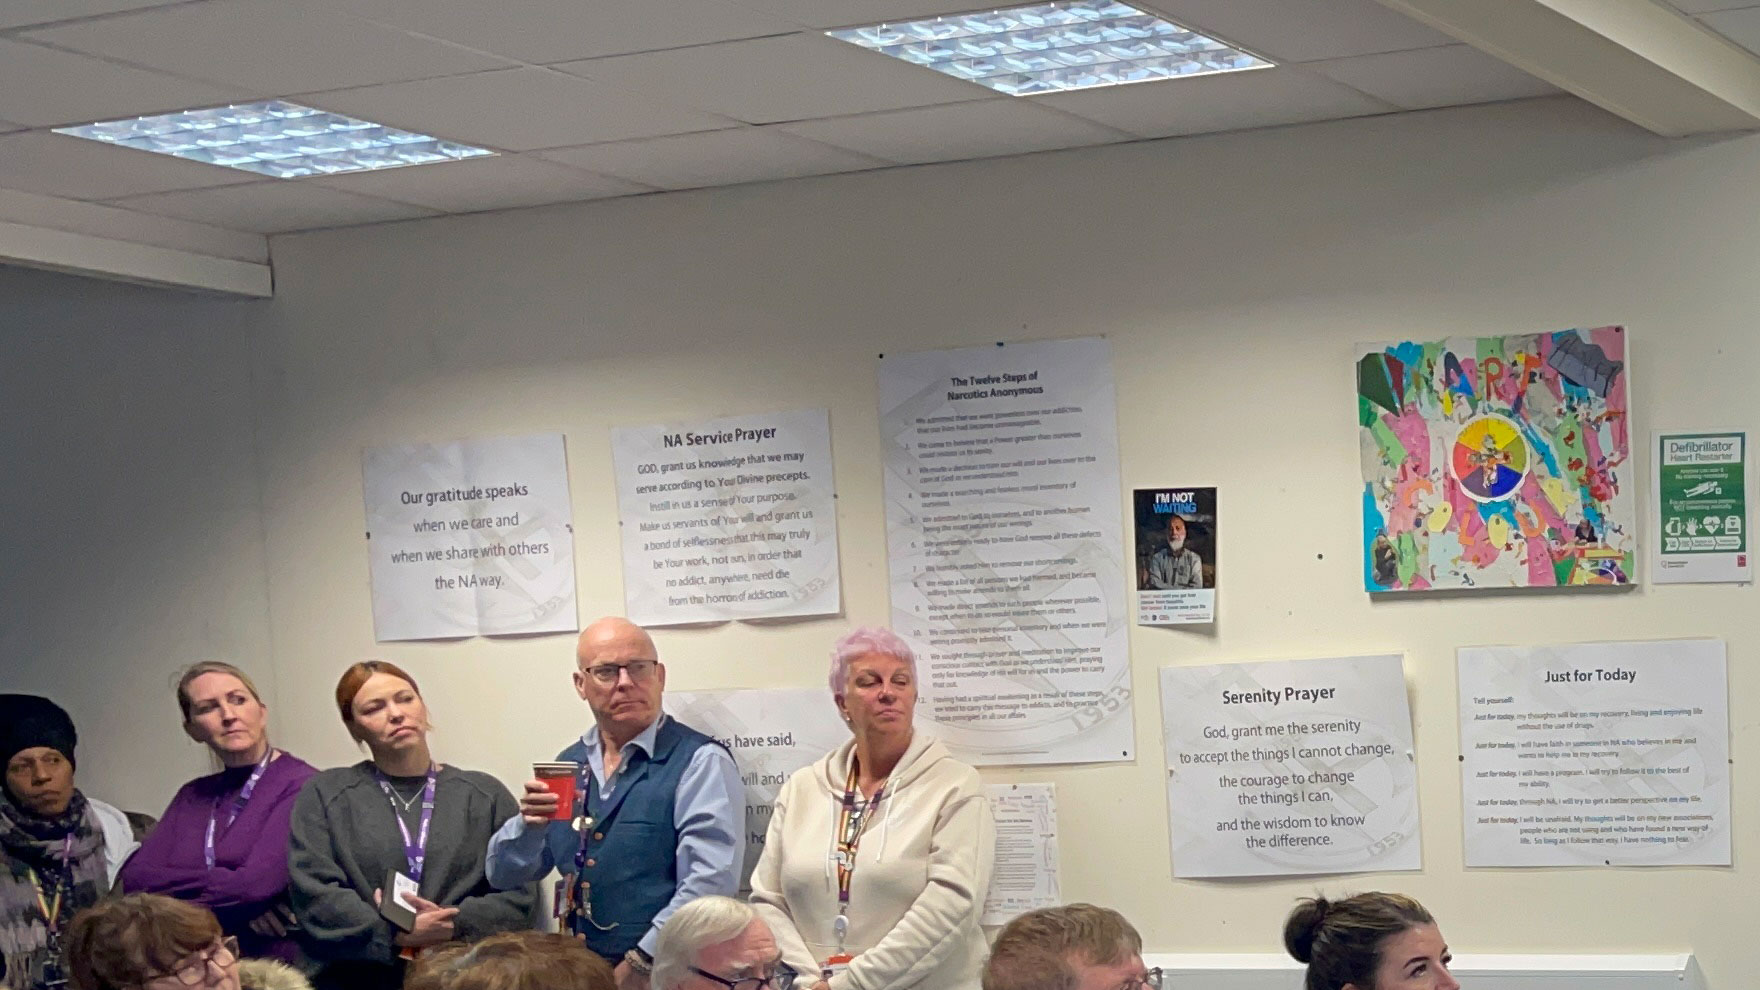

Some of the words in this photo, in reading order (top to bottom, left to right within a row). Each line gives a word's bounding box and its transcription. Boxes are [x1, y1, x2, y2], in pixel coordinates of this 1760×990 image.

[950, 377, 968, 387] The
[970, 375, 1001, 386] Twelve
[1002, 373, 1027, 384] Steps
[1028, 369, 1038, 380] of
[947, 389, 989, 401] Narcotics
[990, 386, 1044, 398] Anonymous
[663, 434, 682, 448] NA
[686, 430, 733, 446] Service
[735, 427, 777, 444] Prayer
[1670, 441, 1733, 453] Defibrillator
[660, 461, 684, 474] grant
[685, 461, 697, 470] us
[747, 454, 765, 464] that
[768, 454, 782, 462] we
[783, 452, 804, 464] may
[401, 491, 422, 505] Our
[426, 486, 483, 506] gratitude
[485, 482, 529, 501] speaks
[658, 479, 702, 493] according
[704, 479, 716, 488] to
[1155, 492, 1170, 503] I'M
[1172, 492, 1195, 503] NOT
[1153, 502, 1197, 514] WAITING
[413, 518, 446, 532] when
[449, 520, 469, 530] we
[470, 518, 493, 529] care
[495, 512, 519, 526] and
[391, 549, 423, 563] when
[425, 551, 443, 561] we
[445, 546, 479, 560] share
[480, 543, 506, 557] with
[508, 541, 549, 555] others
[435, 575, 455, 590] the
[458, 574, 478, 588] NA
[1545, 670, 1571, 683] Just
[1574, 669, 1593, 682] for
[1595, 668, 1636, 684] Today
[1222, 688, 1281, 705] Serenity
[1284, 686, 1336, 703] Prayer
[1203, 725, 1230, 740] God,
[1231, 725, 1263, 740] grant
[1265, 726, 1285, 736] me
[1287, 722, 1309, 735] the
[1311, 719, 1361, 735] serenity
[734, 734, 764, 748] have
[766, 731, 796, 748] said,
[1179, 753, 1191, 764] to
[1193, 751, 1229, 765] accept
[1231, 749, 1250, 761] the
[1252, 747, 1290, 764] things
[1298, 746, 1341, 759] cannot
[1344, 743, 1395, 757] change,
[761, 771, 785, 785] and
[1219, 775, 1238, 788] the
[1240, 775, 1290, 788] courage
[1292, 773, 1305, 785] to
[1307, 771, 1355, 785] change
[1238, 793, 1258, 805] the
[1260, 791, 1299, 806] things
[1308, 791, 1334, 802] can,
[1216, 818, 1238, 832] and
[1240, 818, 1260, 831] the
[1263, 816, 1312, 830] wisdom
[1314, 816, 1328, 828] to
[1330, 814, 1366, 827] know
[1245, 836, 1267, 848] the
[1268, 833, 1334, 848] difference.
